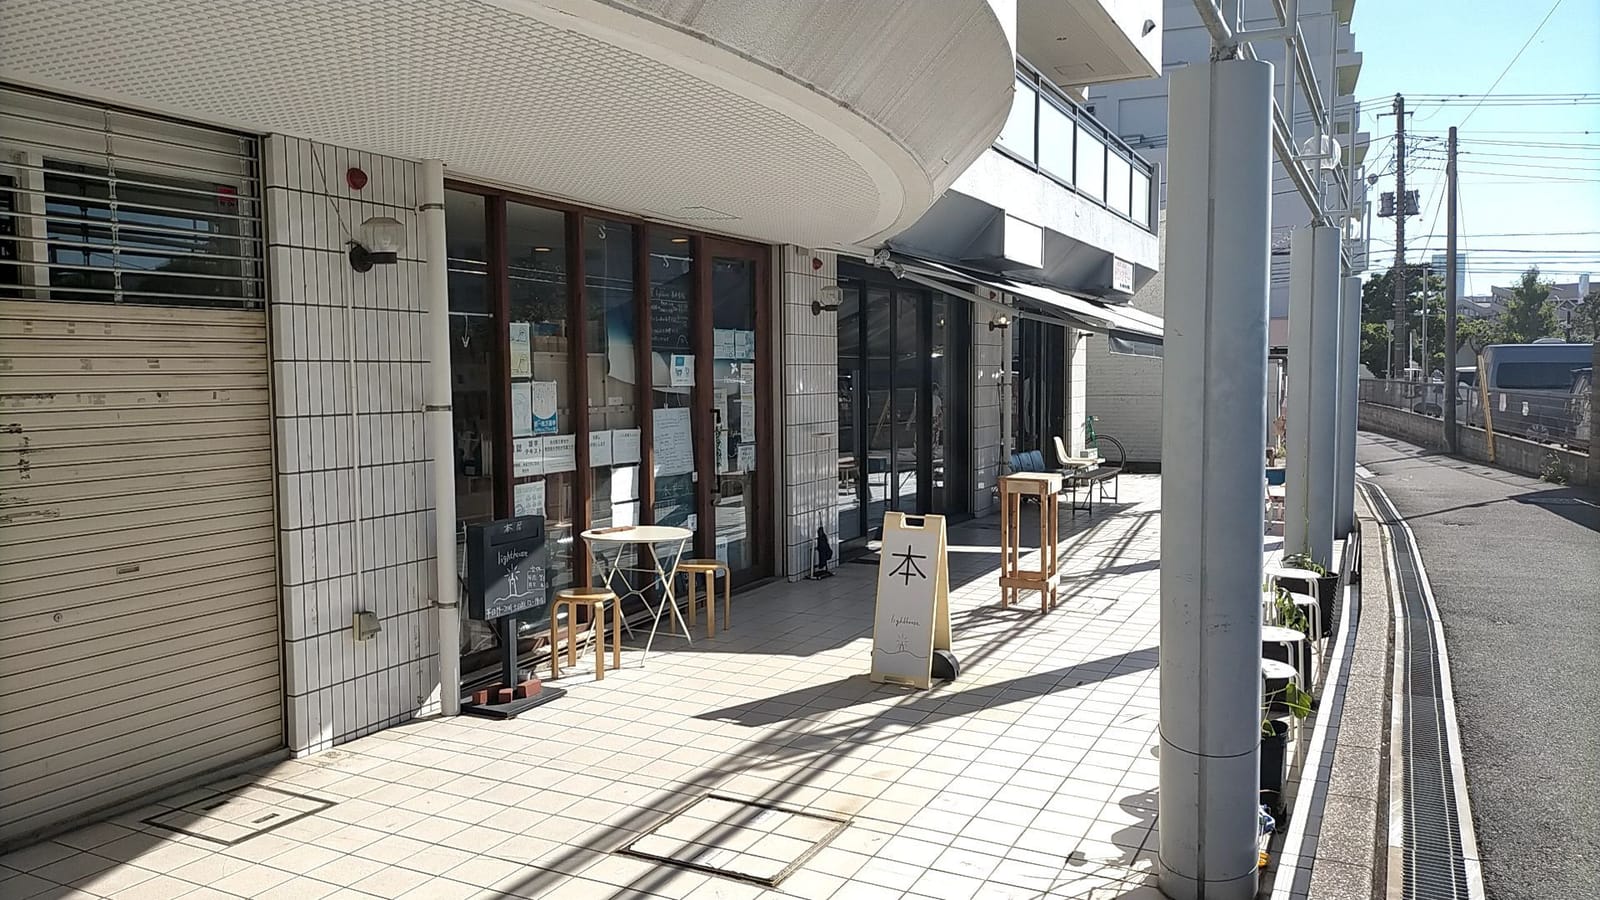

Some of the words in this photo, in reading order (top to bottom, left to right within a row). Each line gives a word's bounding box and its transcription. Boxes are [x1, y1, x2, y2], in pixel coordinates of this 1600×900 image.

[497, 547, 529, 566] lighthouse
[889, 545, 927, 586] 本
[890, 615, 921, 627] lighthouse
